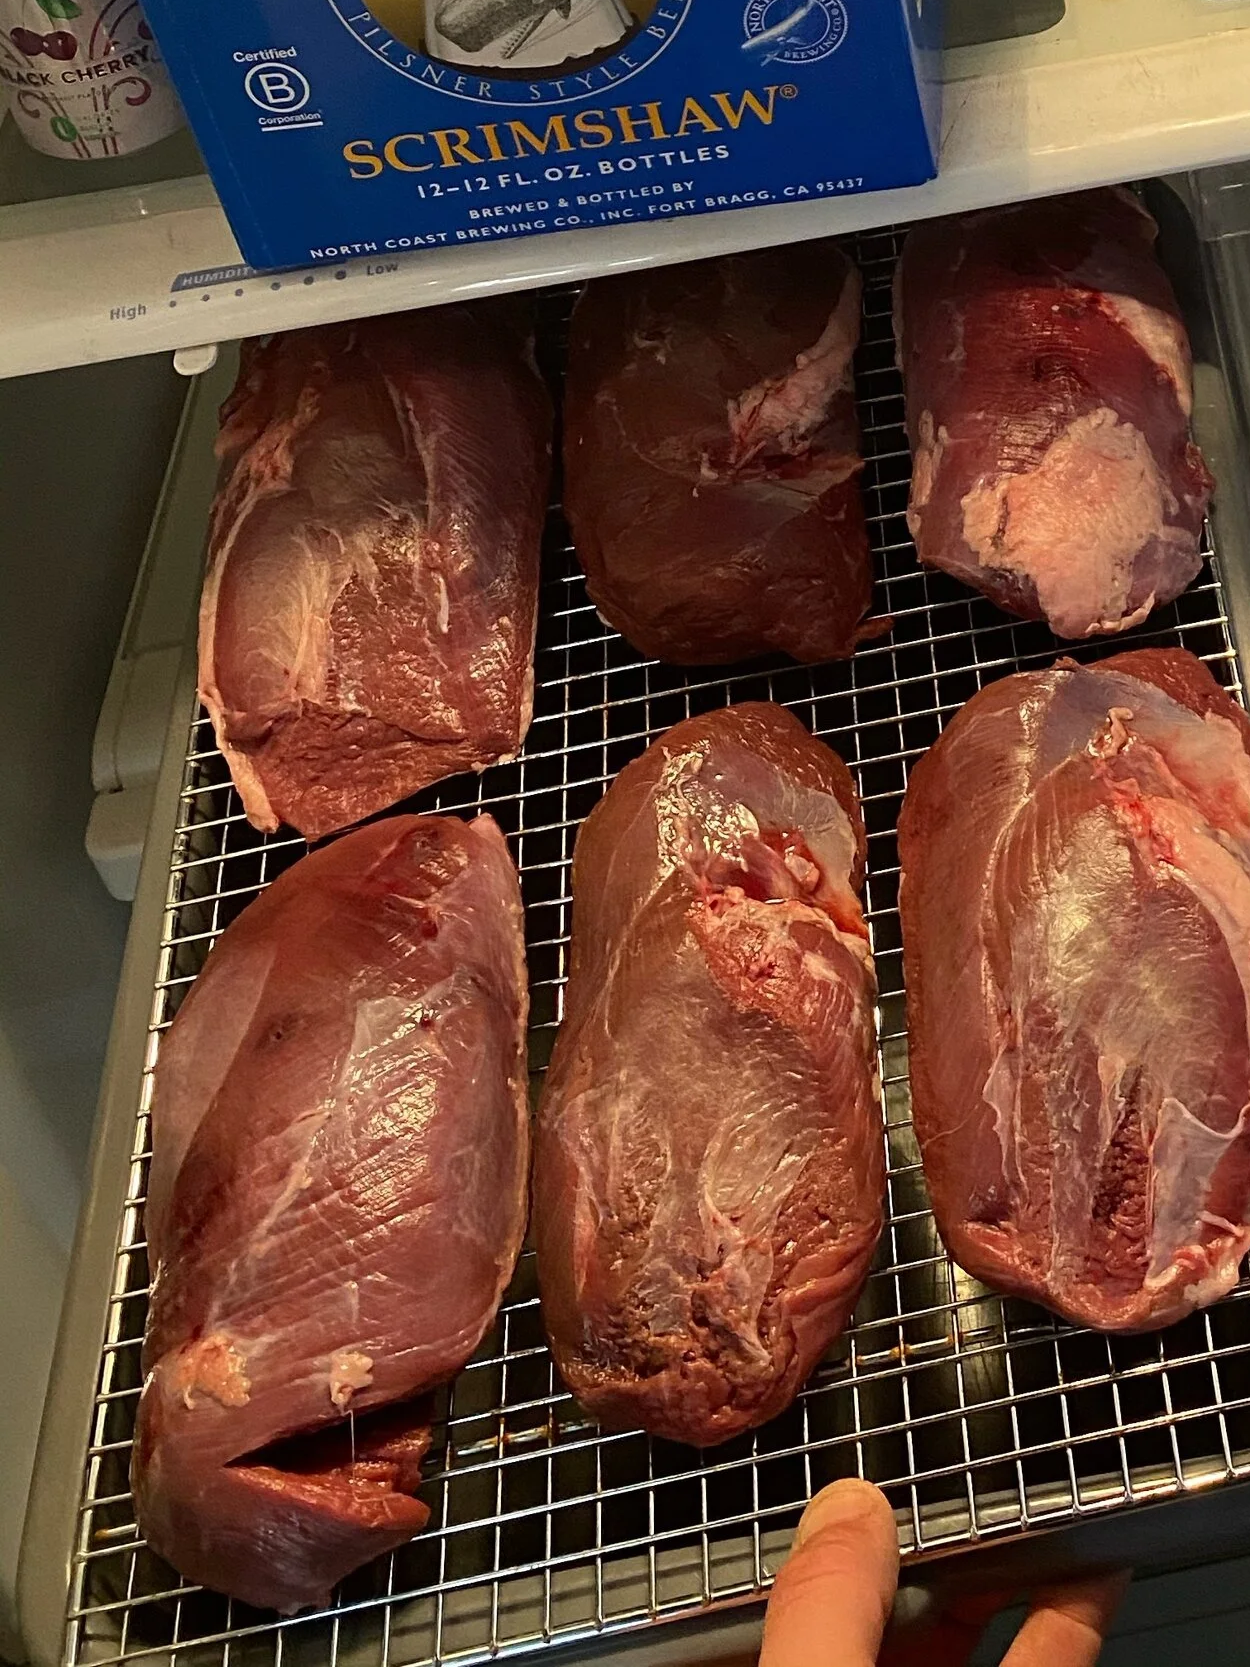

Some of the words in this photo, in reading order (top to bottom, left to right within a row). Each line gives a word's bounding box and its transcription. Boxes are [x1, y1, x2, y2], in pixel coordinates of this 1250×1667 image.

[61, 45, 149, 84] CHERRY
[233, 46, 297, 62] Certified
[348, 11, 491, 97] PILSNER
[530, 52, 638, 100] STYLE
[784, 33, 838, 59] BREWING
[258, 112, 321, 124] Corporation
[498, 172, 539, 188] FL.
[544, 164, 591, 182] OZ.
[599, 144, 730, 176] BOTTLES
[309, 242, 377, 259] NORTH
[385, 232, 448, 249] COAST
[456, 220, 546, 240] BREWING
[601, 208, 641, 221] INC.
[648, 200, 697, 214] FORT
[705, 190, 776, 207] BRAGG,
[783, 185, 809, 196] CA
[816, 177, 864, 193] 95437
[469, 201, 549, 219] BREWED
[558, 198, 569, 208] &
[578, 185, 664, 206] BOTTLED
[672, 181, 695, 193] BY
[110, 303, 147, 320] High
[366, 262, 398, 276] Low
[182, 267, 257, 286] HUMIDIT
